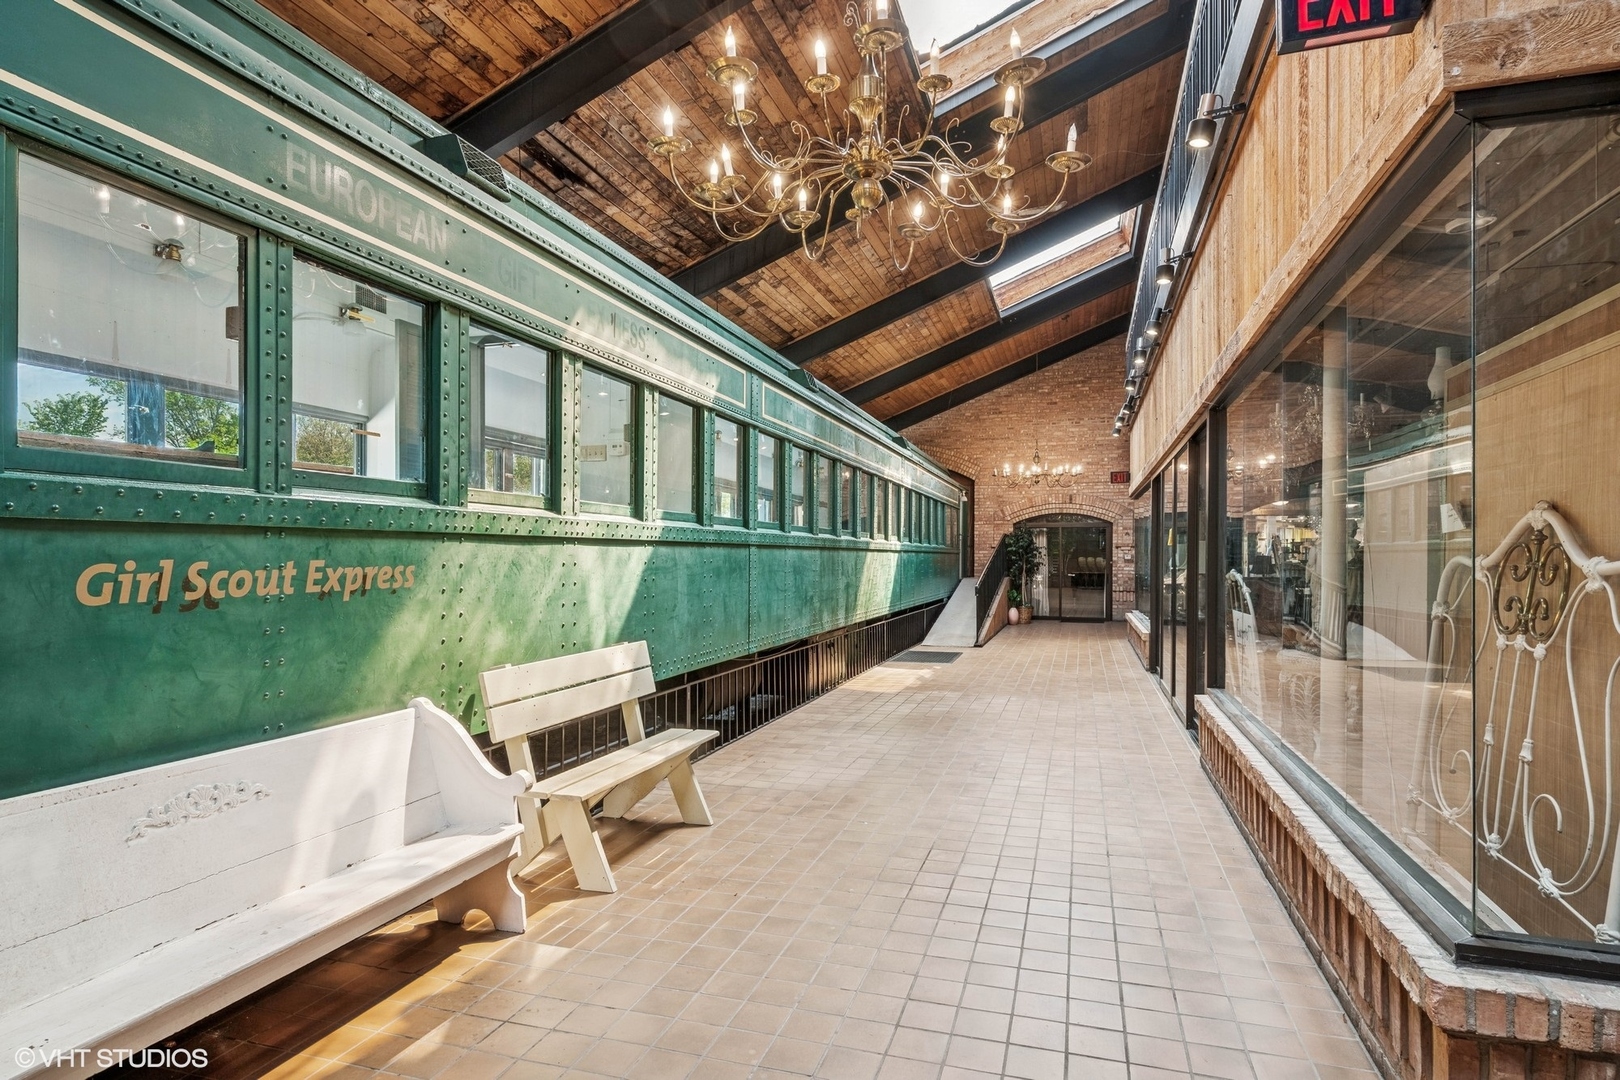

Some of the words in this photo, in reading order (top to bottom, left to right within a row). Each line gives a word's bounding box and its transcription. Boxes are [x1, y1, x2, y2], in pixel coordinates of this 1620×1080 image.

[1298, 0, 1395, 32] EX
[285, 140, 448, 255] EUROPEAN
[497, 253, 541, 301] GIFT
[1113, 472, 1127, 482] EXIT
[75, 558, 175, 607] Girl
[184, 560, 297, 601] Scout
[305, 559, 416, 602] Express
